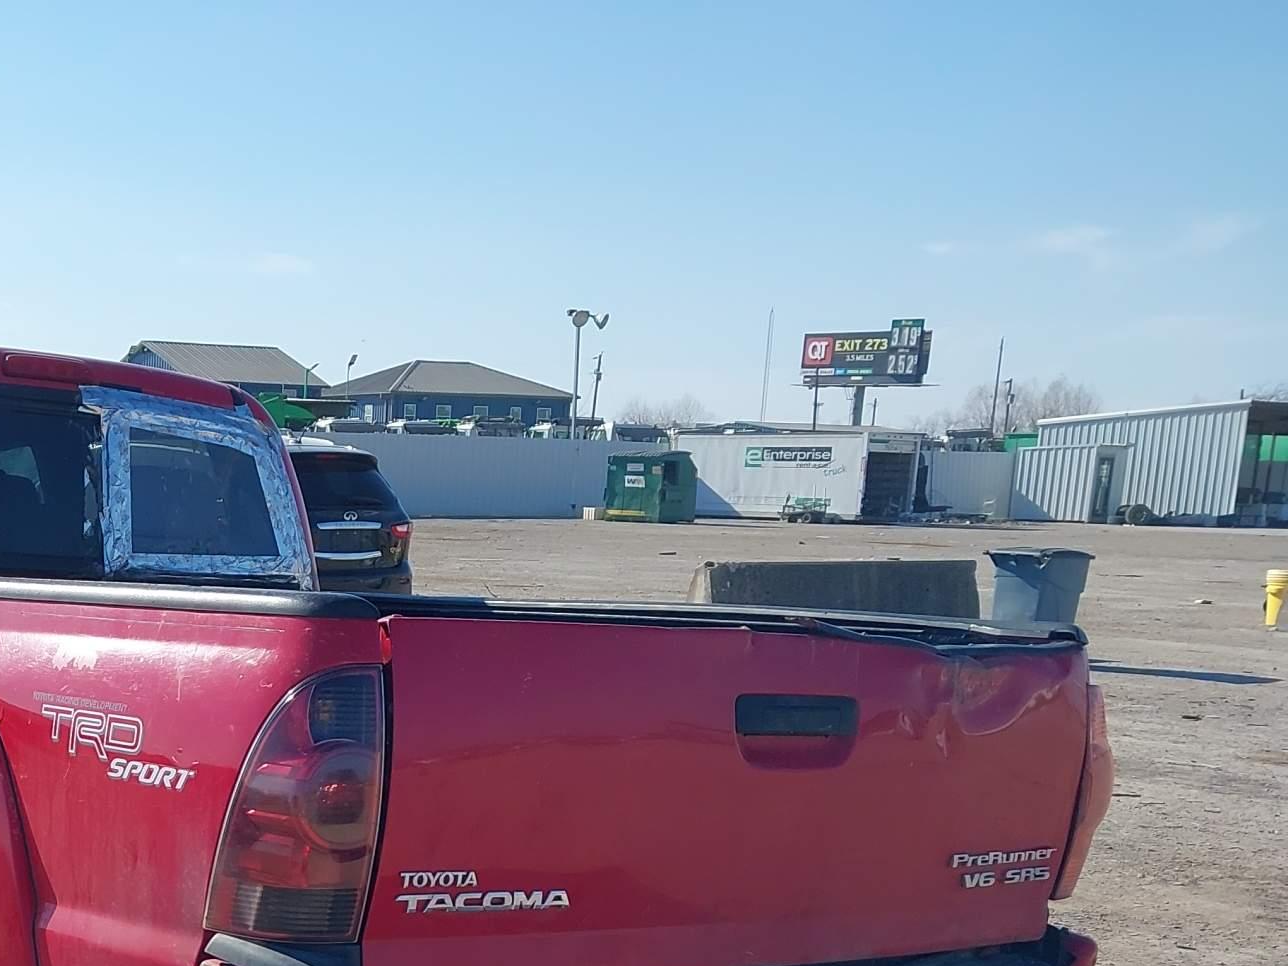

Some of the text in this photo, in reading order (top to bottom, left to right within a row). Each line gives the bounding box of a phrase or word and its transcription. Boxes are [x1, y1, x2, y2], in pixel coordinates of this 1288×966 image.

[808, 341, 829, 361] QT
[835, 338, 889, 352] EXIT 273
[763, 448, 831, 462] Enterprise
[823, 464, 847, 477] truck
[56, 695, 79, 706] RACING
[79, 698, 128, 712] DEVELOPMENT
[41, 703, 145, 761] TRD
[107, 757, 196, 791] SPORT
[952, 848, 1057, 868] PreRunner
[399, 871, 478, 888] TOYOTA
[964, 866, 1050, 889] V6 SR5
[394, 890, 570, 914] TACOMA
